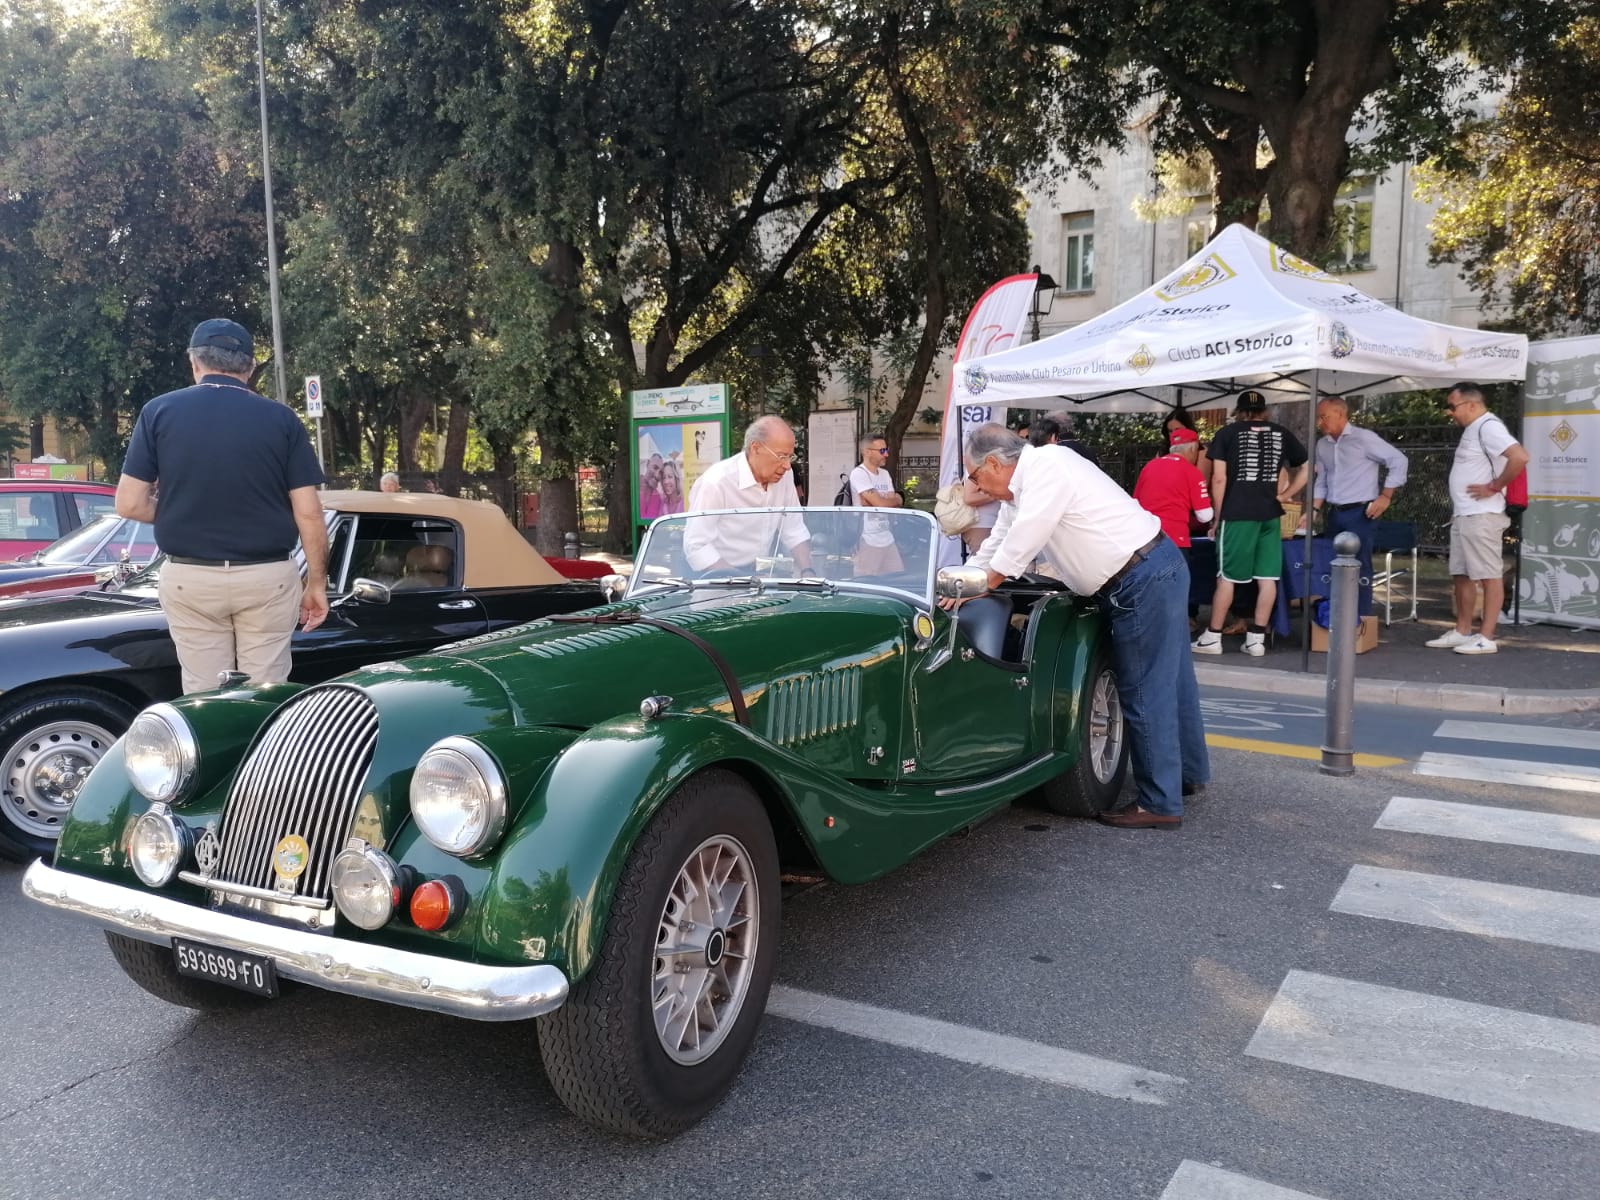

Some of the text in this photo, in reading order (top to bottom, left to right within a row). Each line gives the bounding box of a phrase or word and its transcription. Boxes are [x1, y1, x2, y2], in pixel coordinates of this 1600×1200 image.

[1156, 303, 1231, 317] Storico
[1167, 332, 1293, 362] Club ACI Storico
[1031, 368, 1050, 380] Club
[1052, 365, 1081, 377] Pesaro
[1083, 366, 1089, 375] e
[1091, 361, 1121, 374] Urbino
[178, 945, 237, 981] 593699
